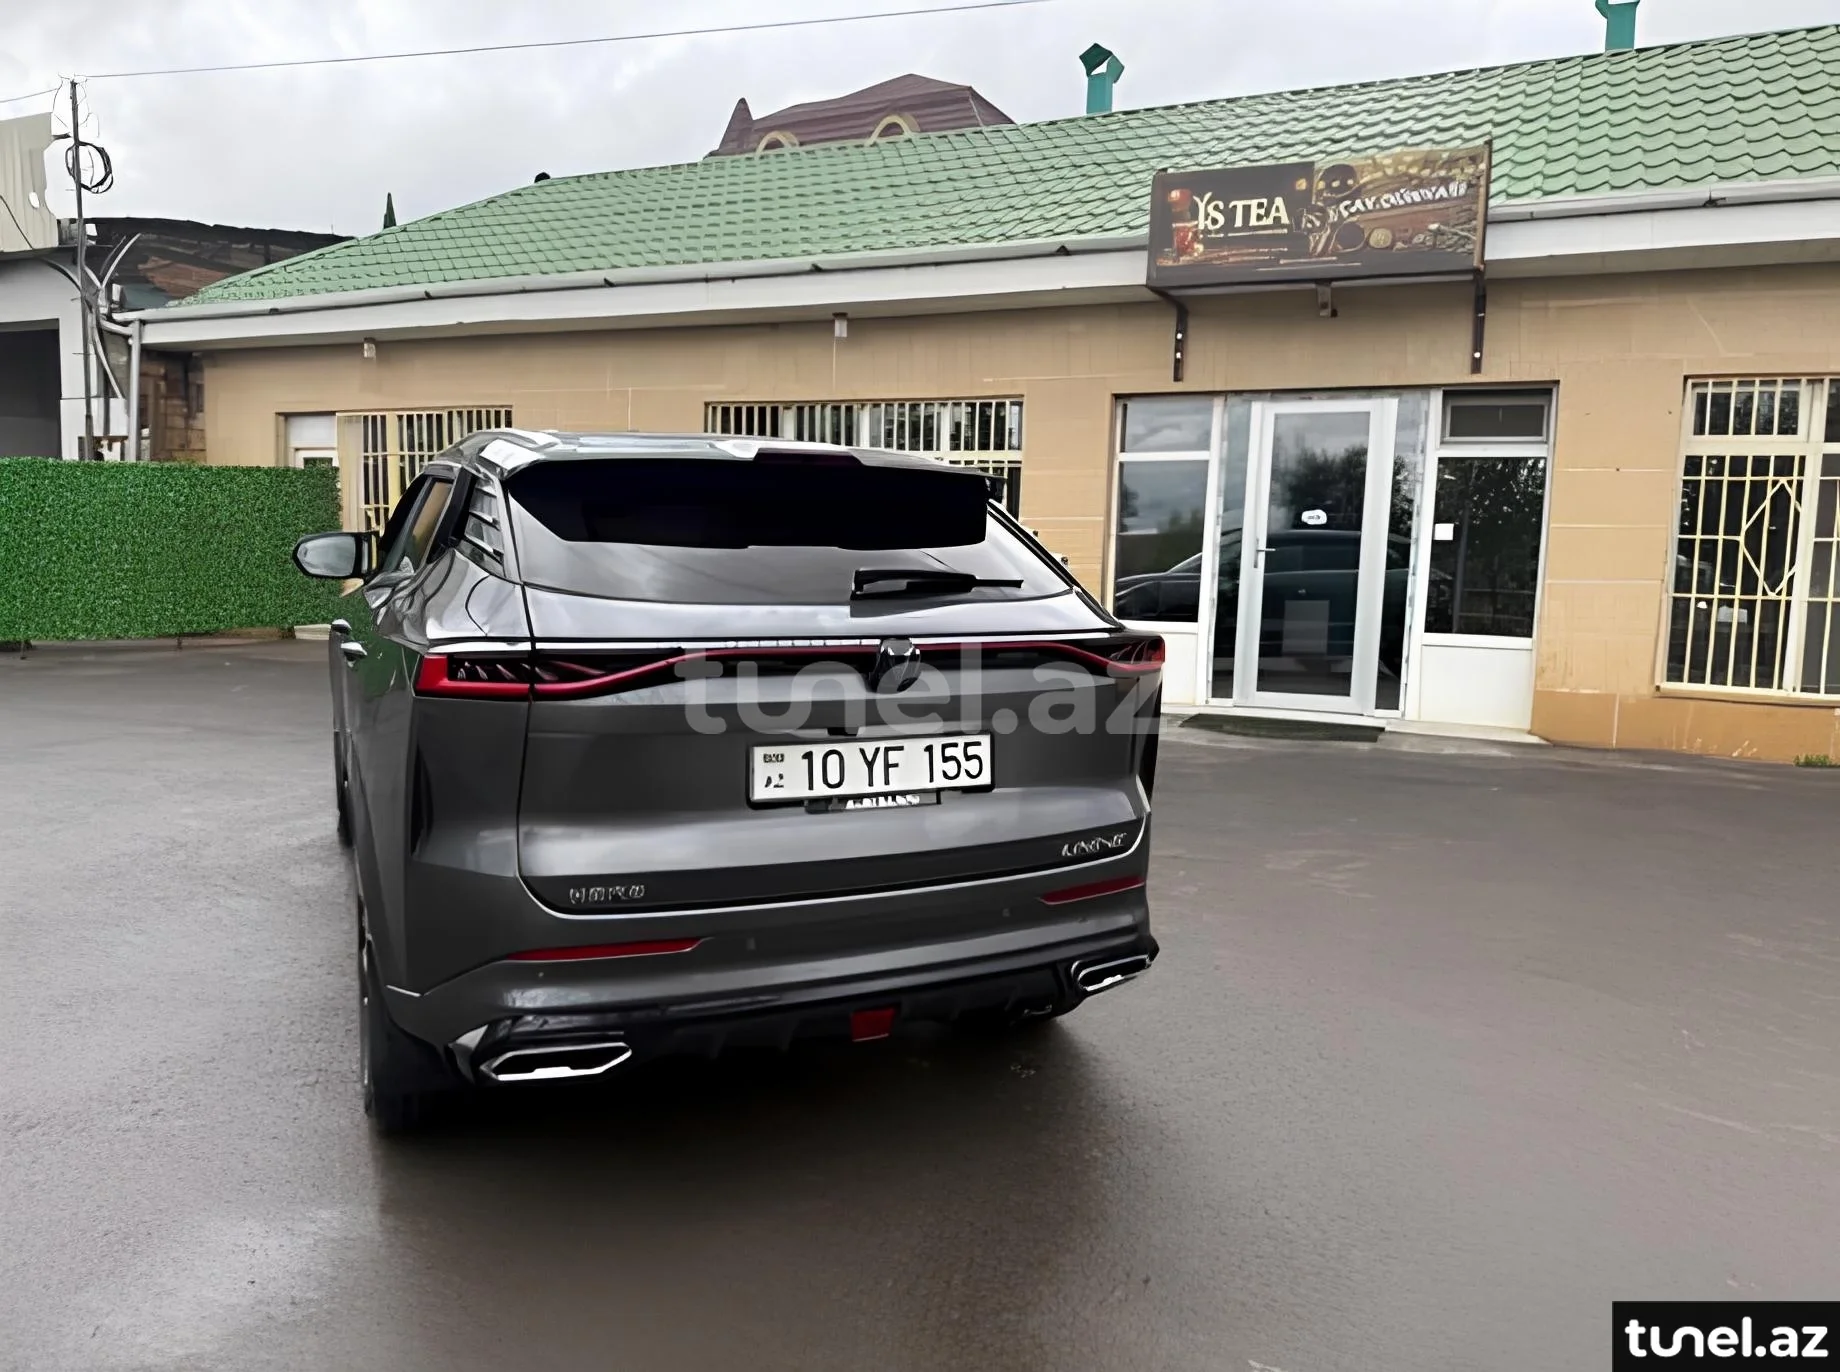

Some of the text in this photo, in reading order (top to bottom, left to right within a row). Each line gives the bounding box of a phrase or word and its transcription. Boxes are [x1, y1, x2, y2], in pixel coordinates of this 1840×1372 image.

[1228, 196, 1290, 227] TEA
[801, 741, 983, 791] 10 YF 155
